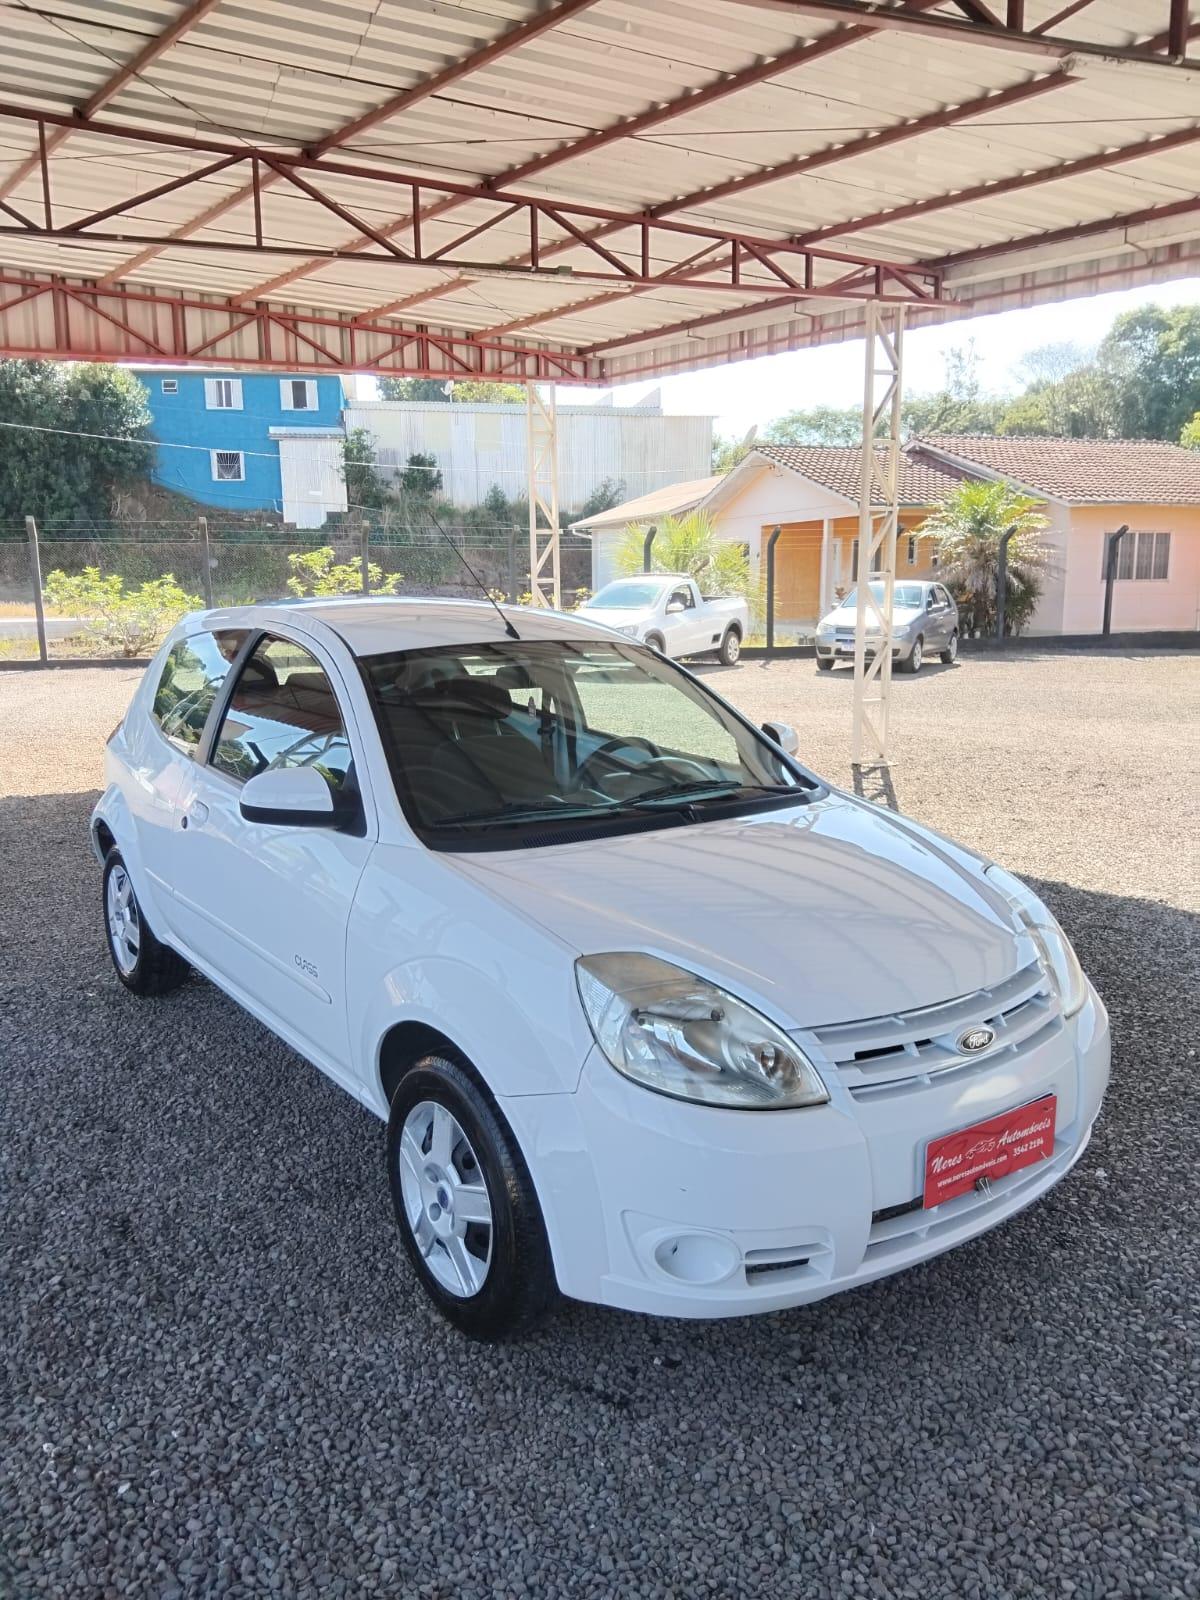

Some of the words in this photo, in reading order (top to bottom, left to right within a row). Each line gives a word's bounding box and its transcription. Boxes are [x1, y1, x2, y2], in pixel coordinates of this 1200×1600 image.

[969, 1032, 989, 1049] Ford
[931, 1153, 962, 1174] Neres
[996, 1118, 1051, 1149] Automóveis
